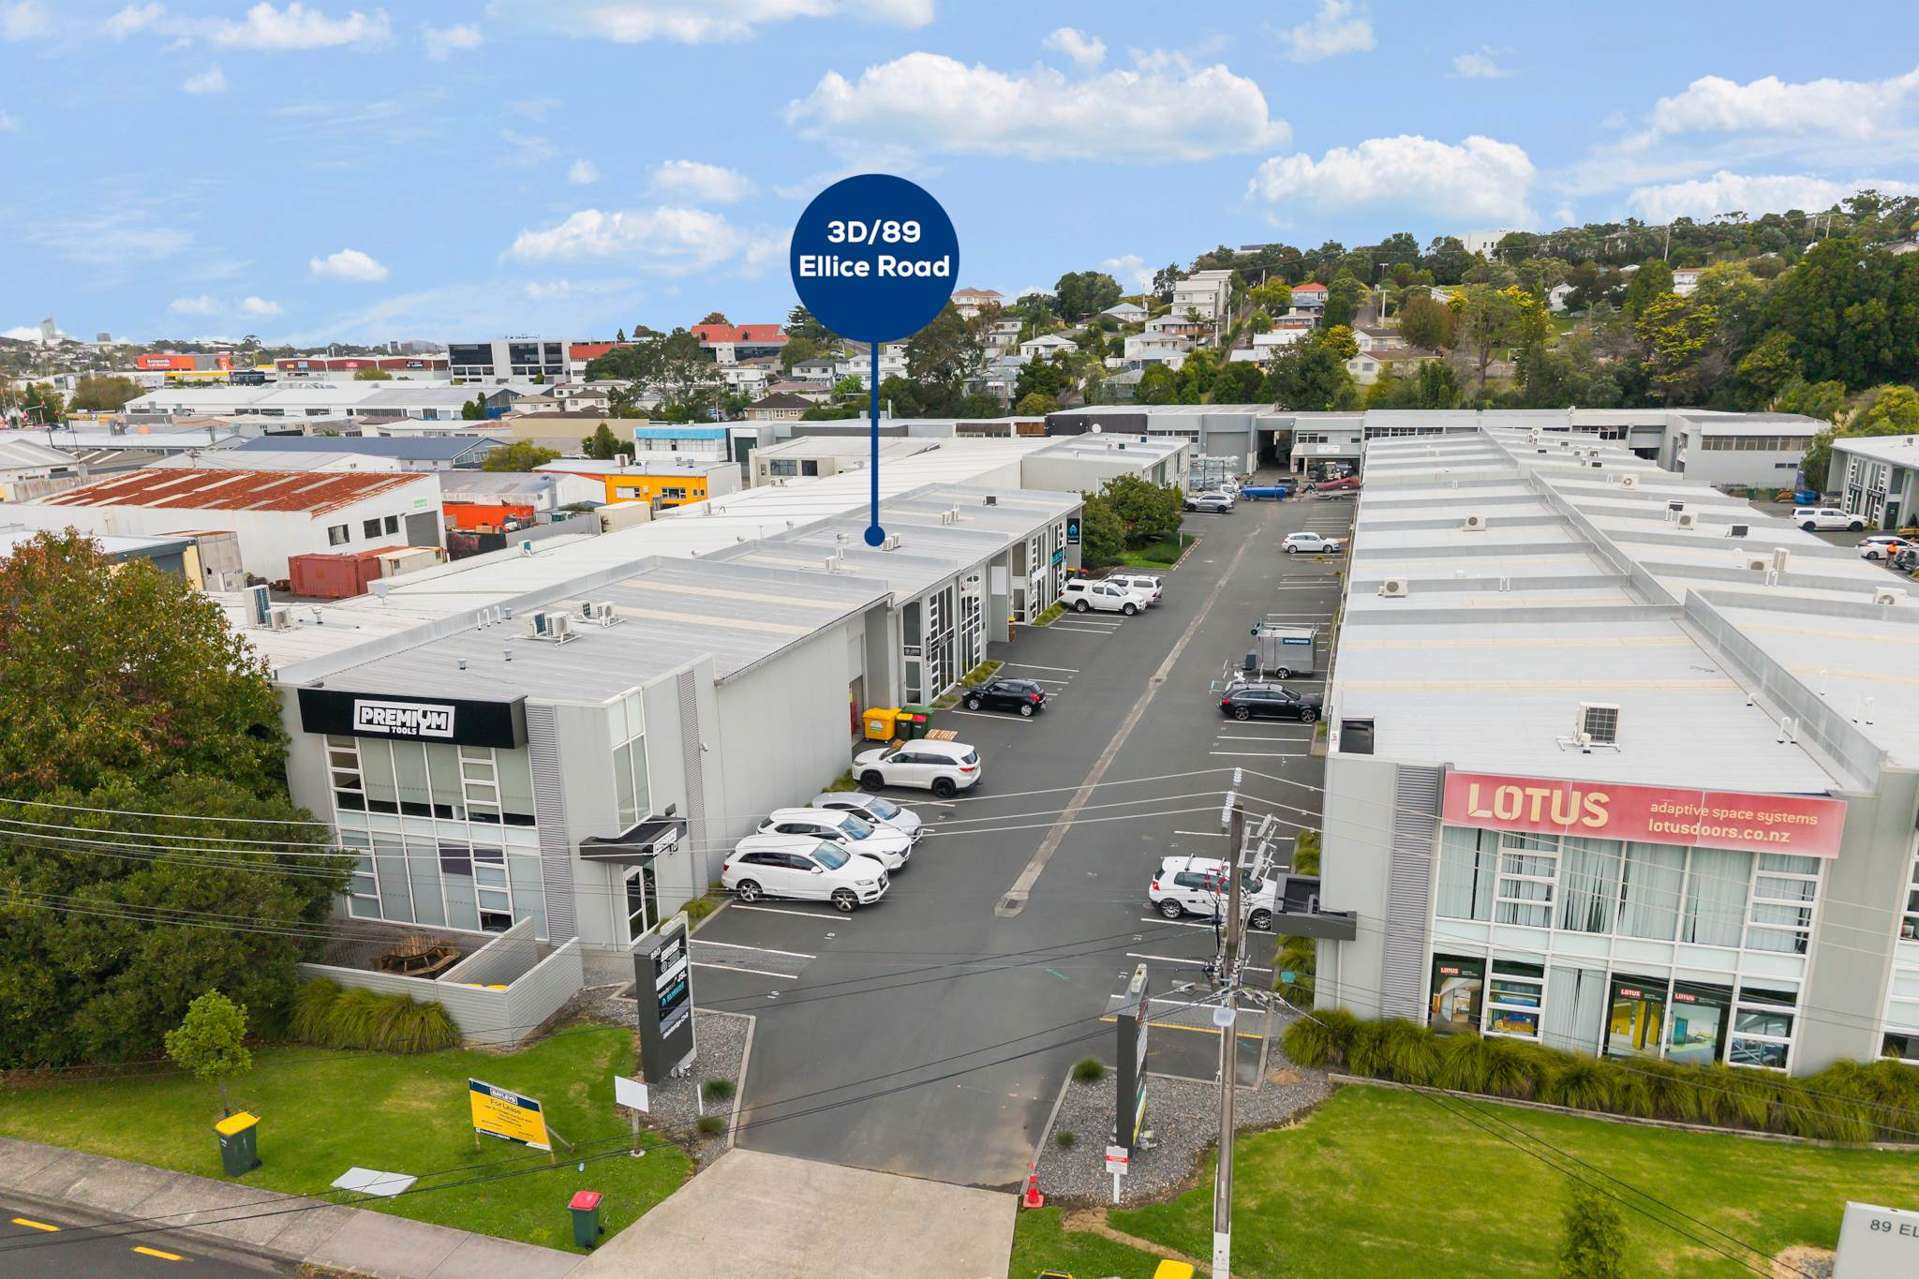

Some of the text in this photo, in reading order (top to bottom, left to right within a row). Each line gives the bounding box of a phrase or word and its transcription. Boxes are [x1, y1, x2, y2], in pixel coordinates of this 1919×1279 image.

[361, 706, 447, 729] PREMIUM
[391, 726, 417, 735] TOOLS
[1468, 783, 1611, 828] LOTUS
[1650, 801, 1818, 825] adaptive space systems
[1648, 818, 1792, 843] lotusdoors.co.nz
[1440, 967, 1459, 975] LOTUS
[1621, 988, 1641, 997] LOTUS
[1675, 993, 1696, 1001] LOTUS
[1870, 1219, 1919, 1238] 89 EL
